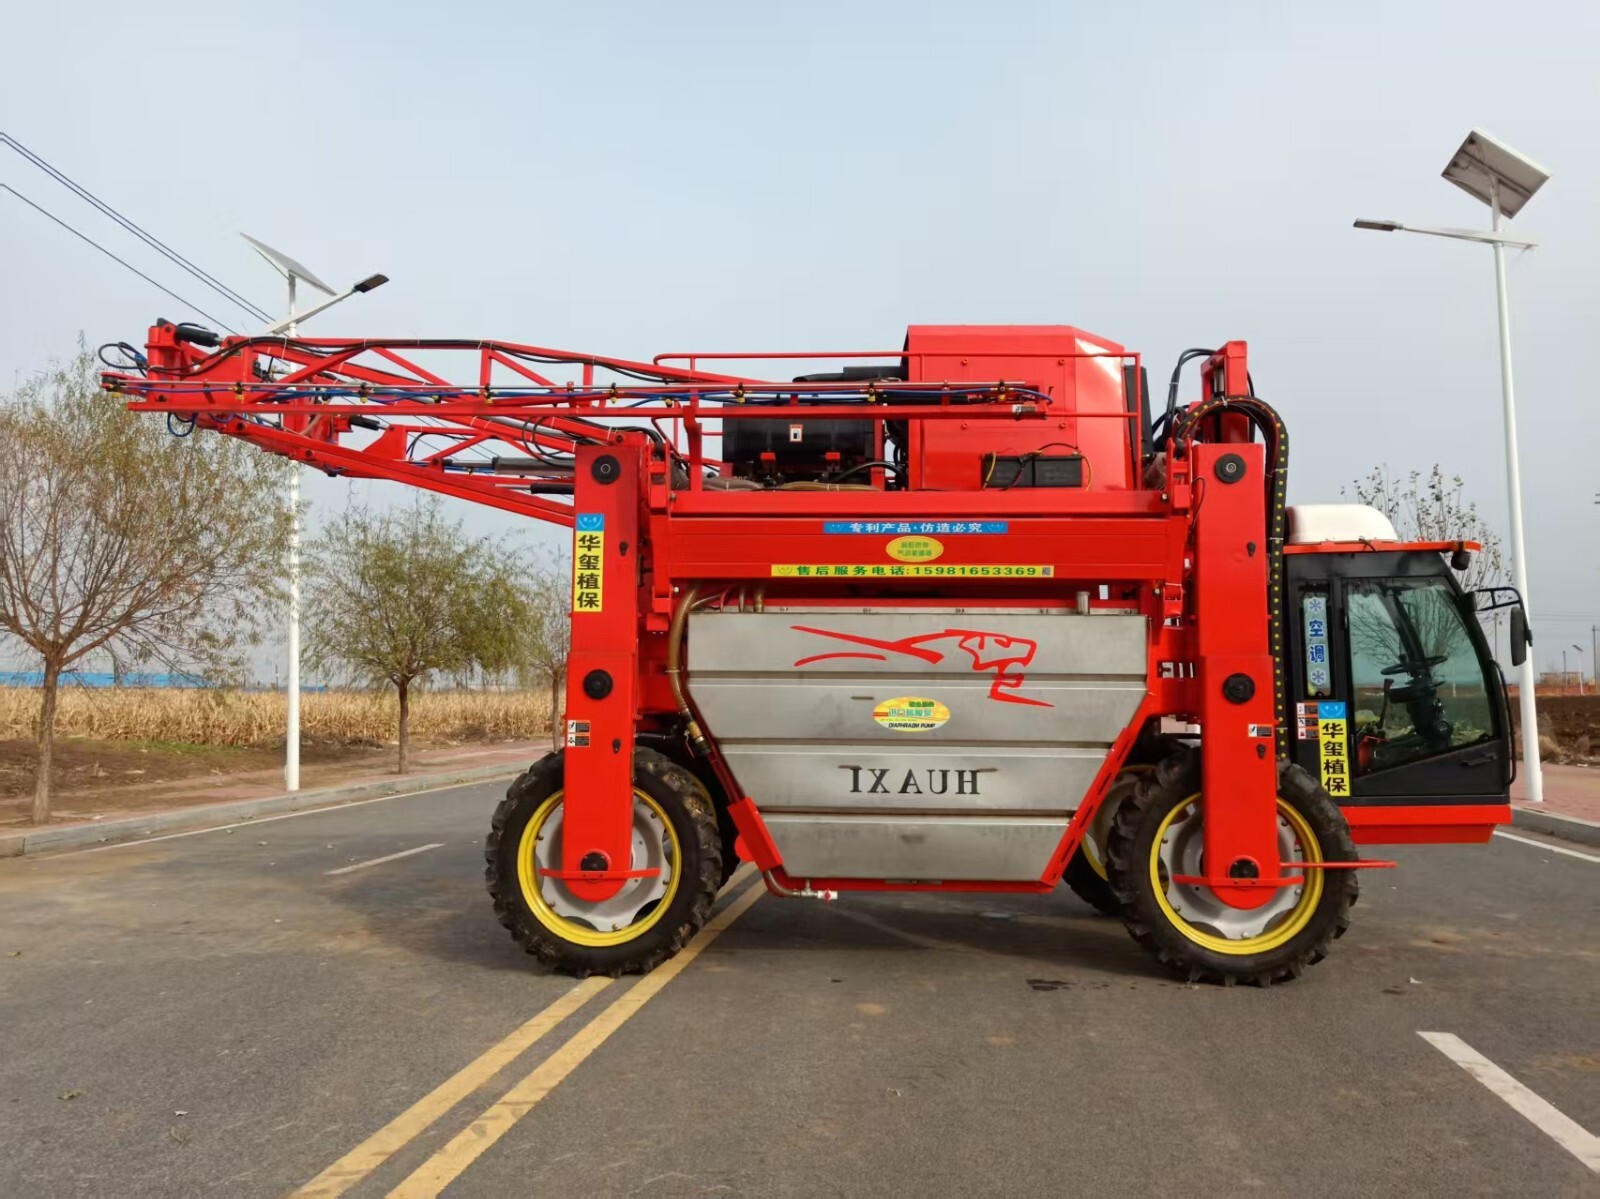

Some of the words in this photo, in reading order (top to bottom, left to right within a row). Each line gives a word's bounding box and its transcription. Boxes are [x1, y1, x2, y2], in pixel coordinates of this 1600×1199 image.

[577, 534, 601, 609] 华玺植保
[1309, 619, 1324, 663] 空调
[1322, 722, 1347, 793] 华玺植保
